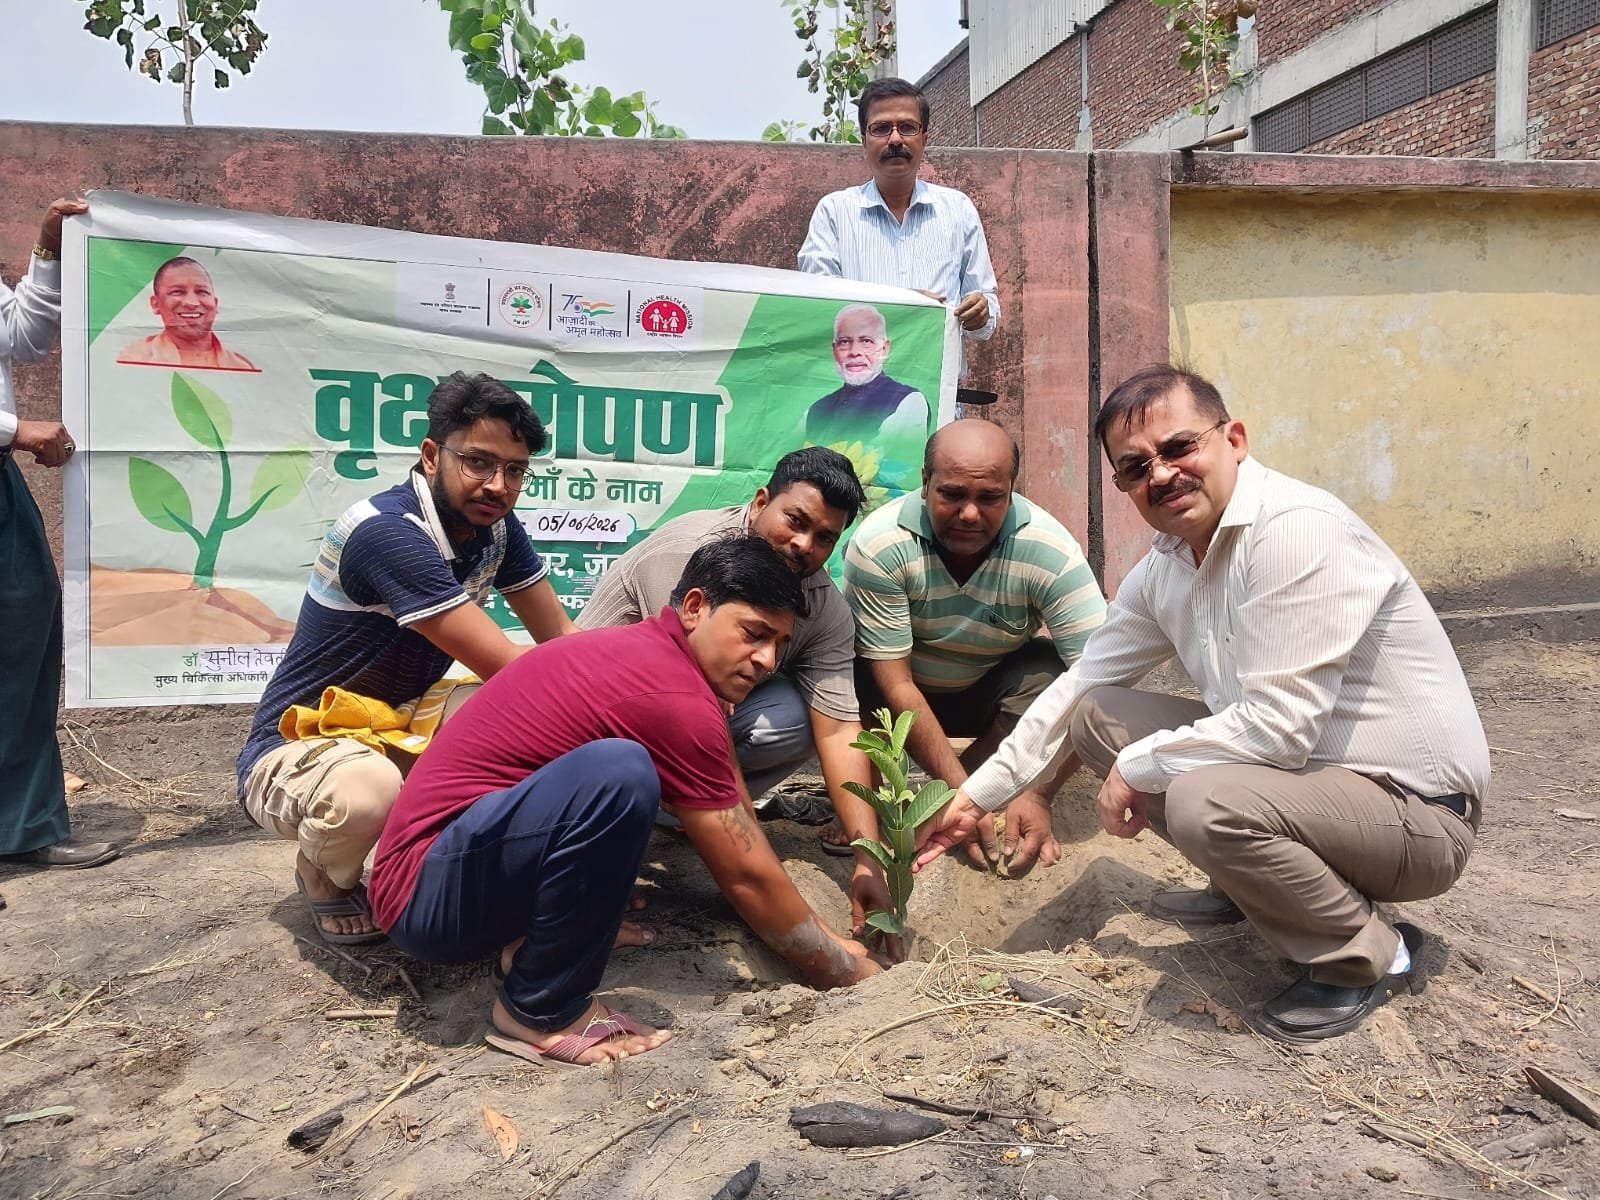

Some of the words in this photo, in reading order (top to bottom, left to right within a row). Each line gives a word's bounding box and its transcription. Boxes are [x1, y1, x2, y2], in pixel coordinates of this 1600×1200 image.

[635, 296, 656, 324] NATIONAL
[656, 294, 682, 305] HEALTH
[681, 302, 694, 330] MISSION
[566, 326, 588, 338] अमृत
[589, 325, 623, 338] महोत्सव
[308, 359, 724, 480] वृक्षरोपण
[566, 467, 598, 502] के
[605, 478, 664, 505] नाम
[203, 646, 251, 672] सुनील
[153, 674, 179, 689] मुख्य
[181, 670, 224, 684] चिकित्सा
[226, 670, 269, 683] अधिकारी
